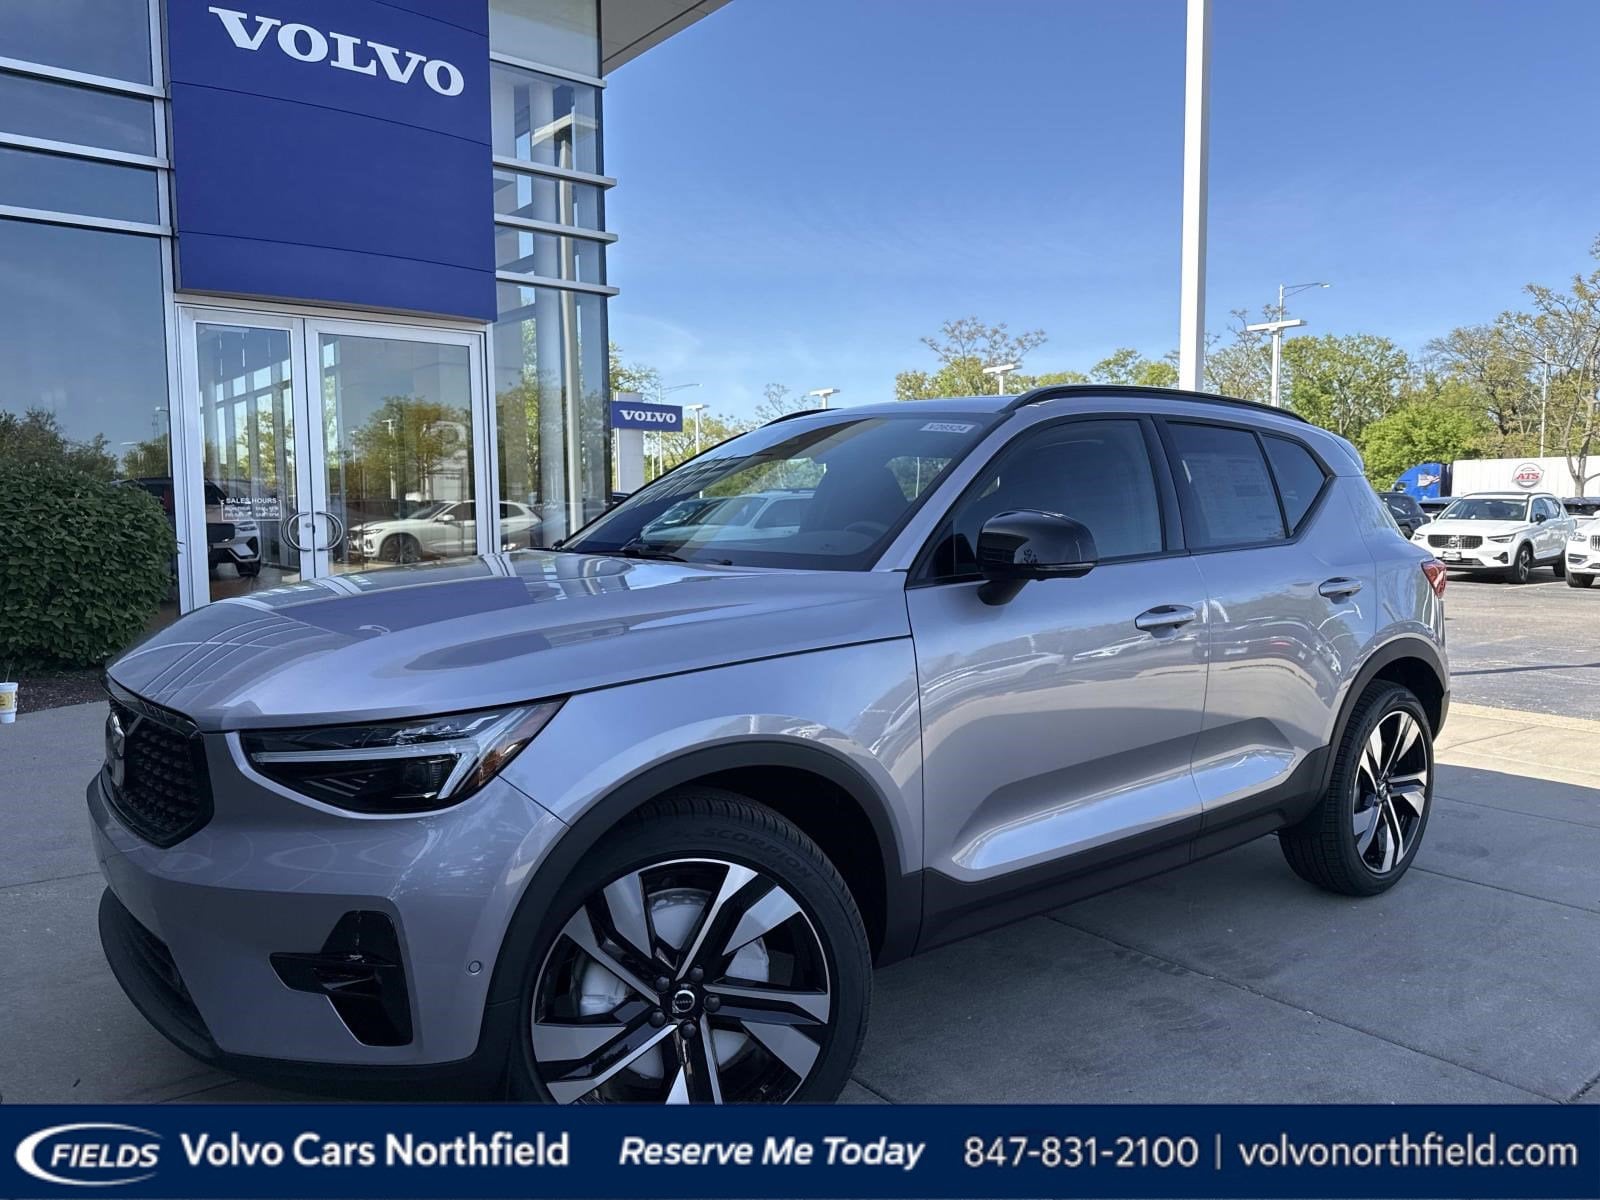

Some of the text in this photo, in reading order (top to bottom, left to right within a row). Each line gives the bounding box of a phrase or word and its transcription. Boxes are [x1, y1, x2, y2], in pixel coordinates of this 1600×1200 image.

[208, 6, 465, 97] VOLVO
[619, 409, 677, 424] VOLVO
[1516, 472, 1540, 480] ATS
[704, 827, 814, 879] SCORPION
